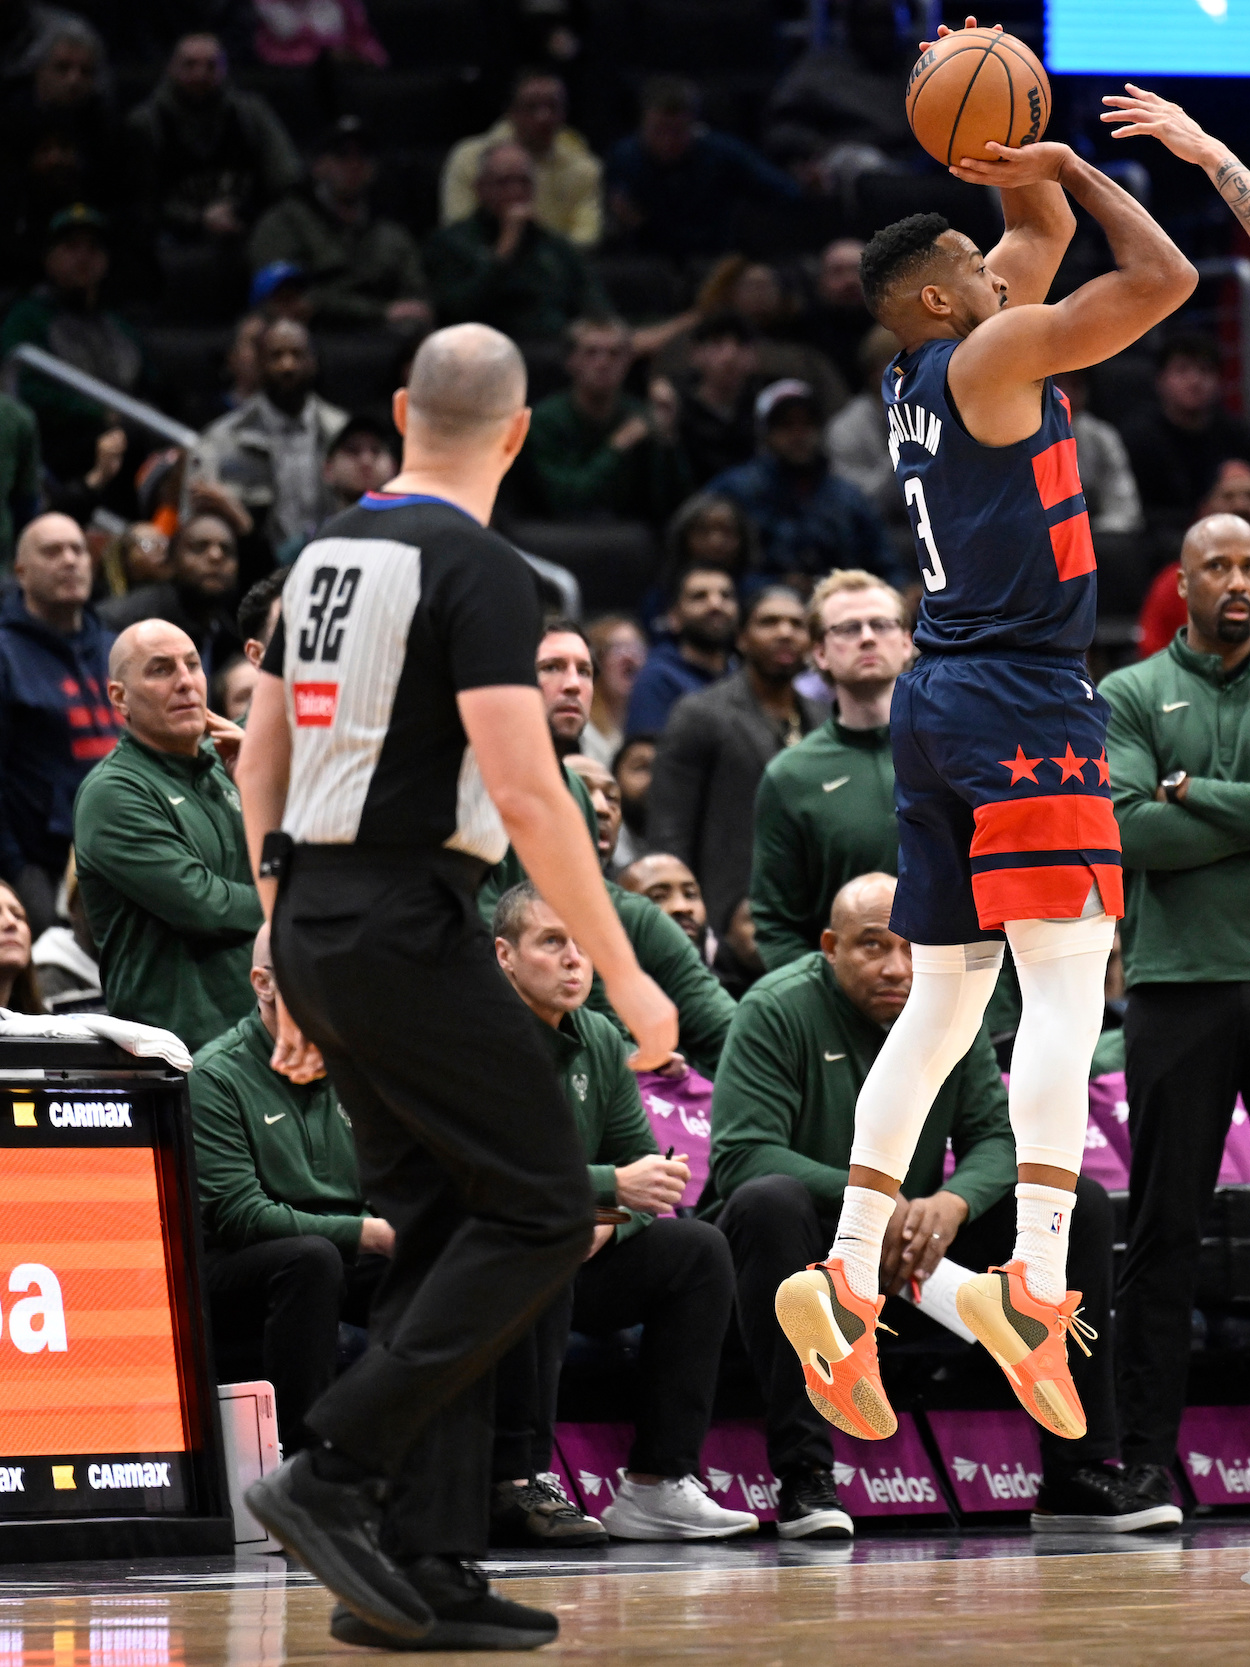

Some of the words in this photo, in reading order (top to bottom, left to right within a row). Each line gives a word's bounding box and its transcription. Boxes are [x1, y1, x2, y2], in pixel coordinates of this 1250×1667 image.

[904, 477, 947, 593] 3
[298, 566, 362, 662] 32
[678, 1105, 712, 1138] lei
[0, 1262, 68, 1354] a
[859, 1466, 938, 1504] leidos
